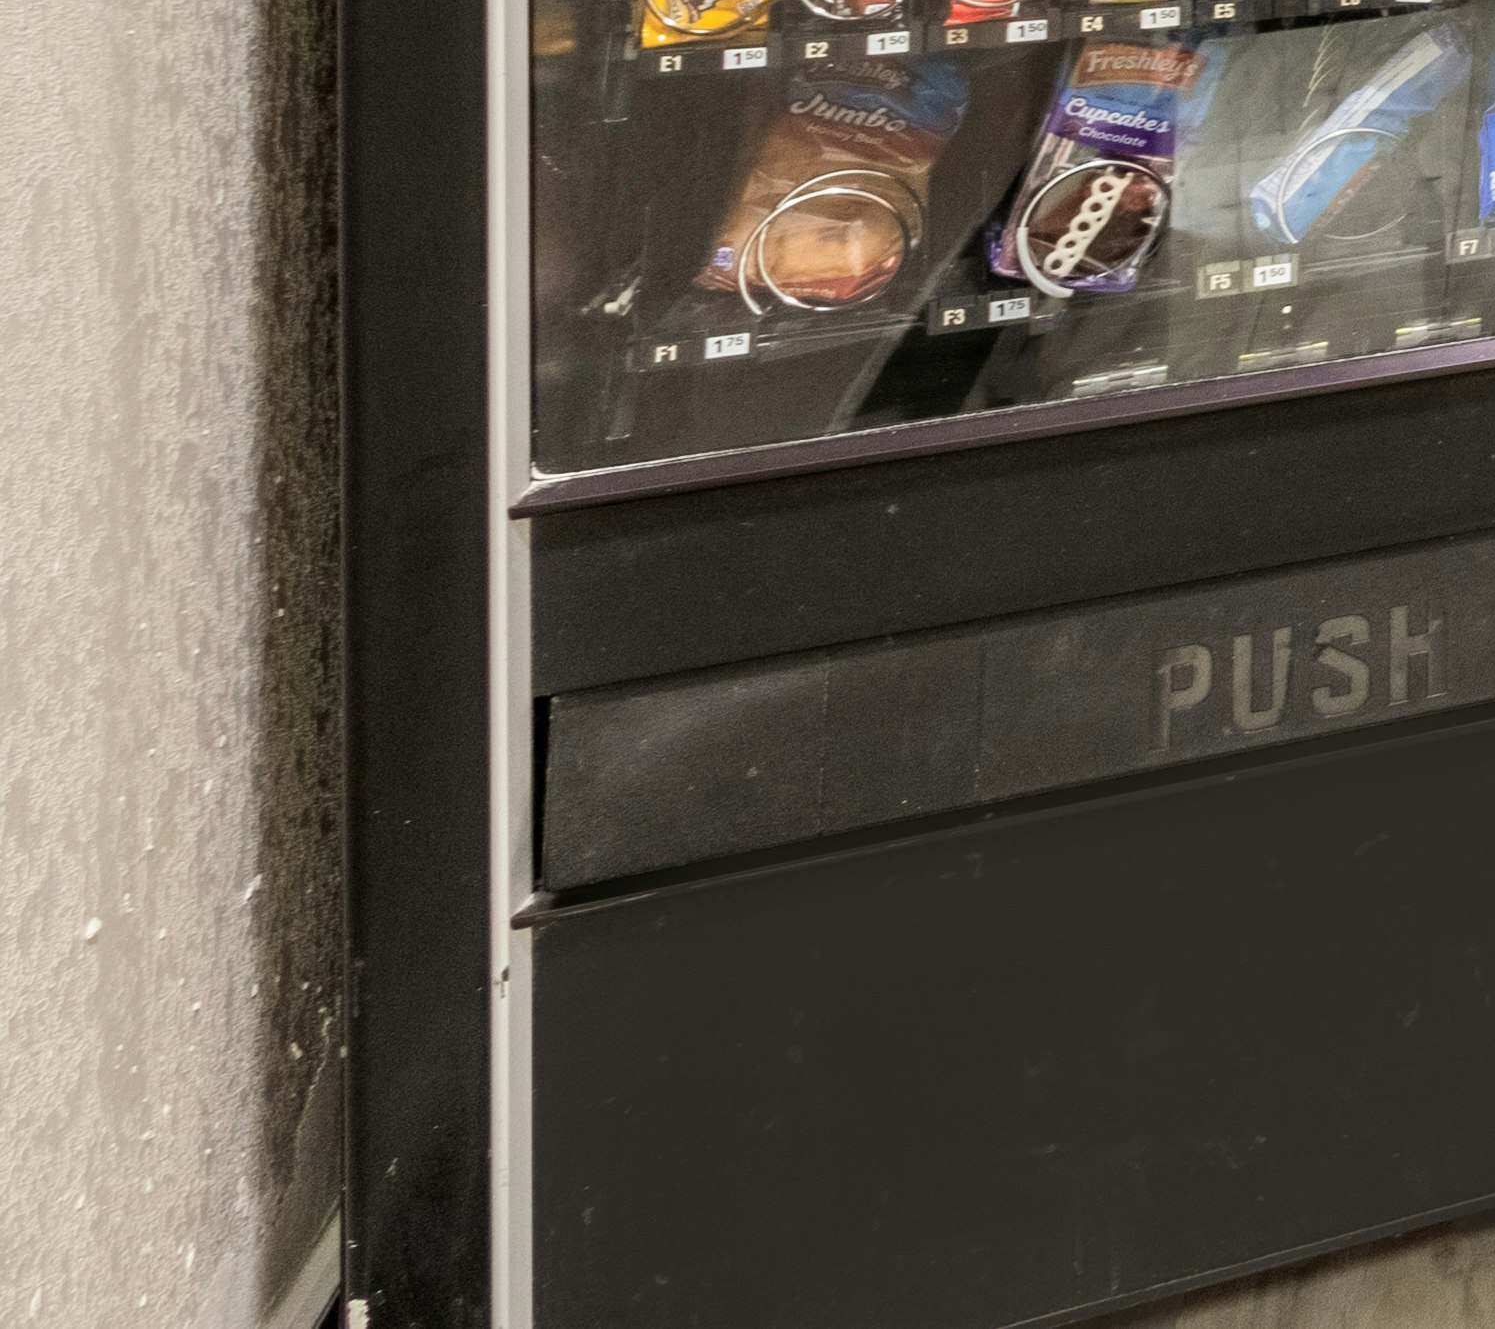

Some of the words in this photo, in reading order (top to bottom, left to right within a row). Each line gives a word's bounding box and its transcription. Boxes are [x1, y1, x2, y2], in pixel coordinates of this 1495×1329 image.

[1213, 3, 1236, 19] E5
[947, 29, 968, 44] E3
[660, 55, 682, 72] E1
[1086, 50, 1198, 80] Freshley's
[790, 93, 907, 133] Jumbo
[1064, 96, 1172, 134] Cupcakes
[1078, 126, 1148, 149] Chocolate
[1459, 239, 1479, 256] F7
[1210, 273, 1231, 290] F5
[943, 309, 966, 325] F3
[654, 344, 679, 363] F1
[1149, 604, 1448, 753] PUSH
